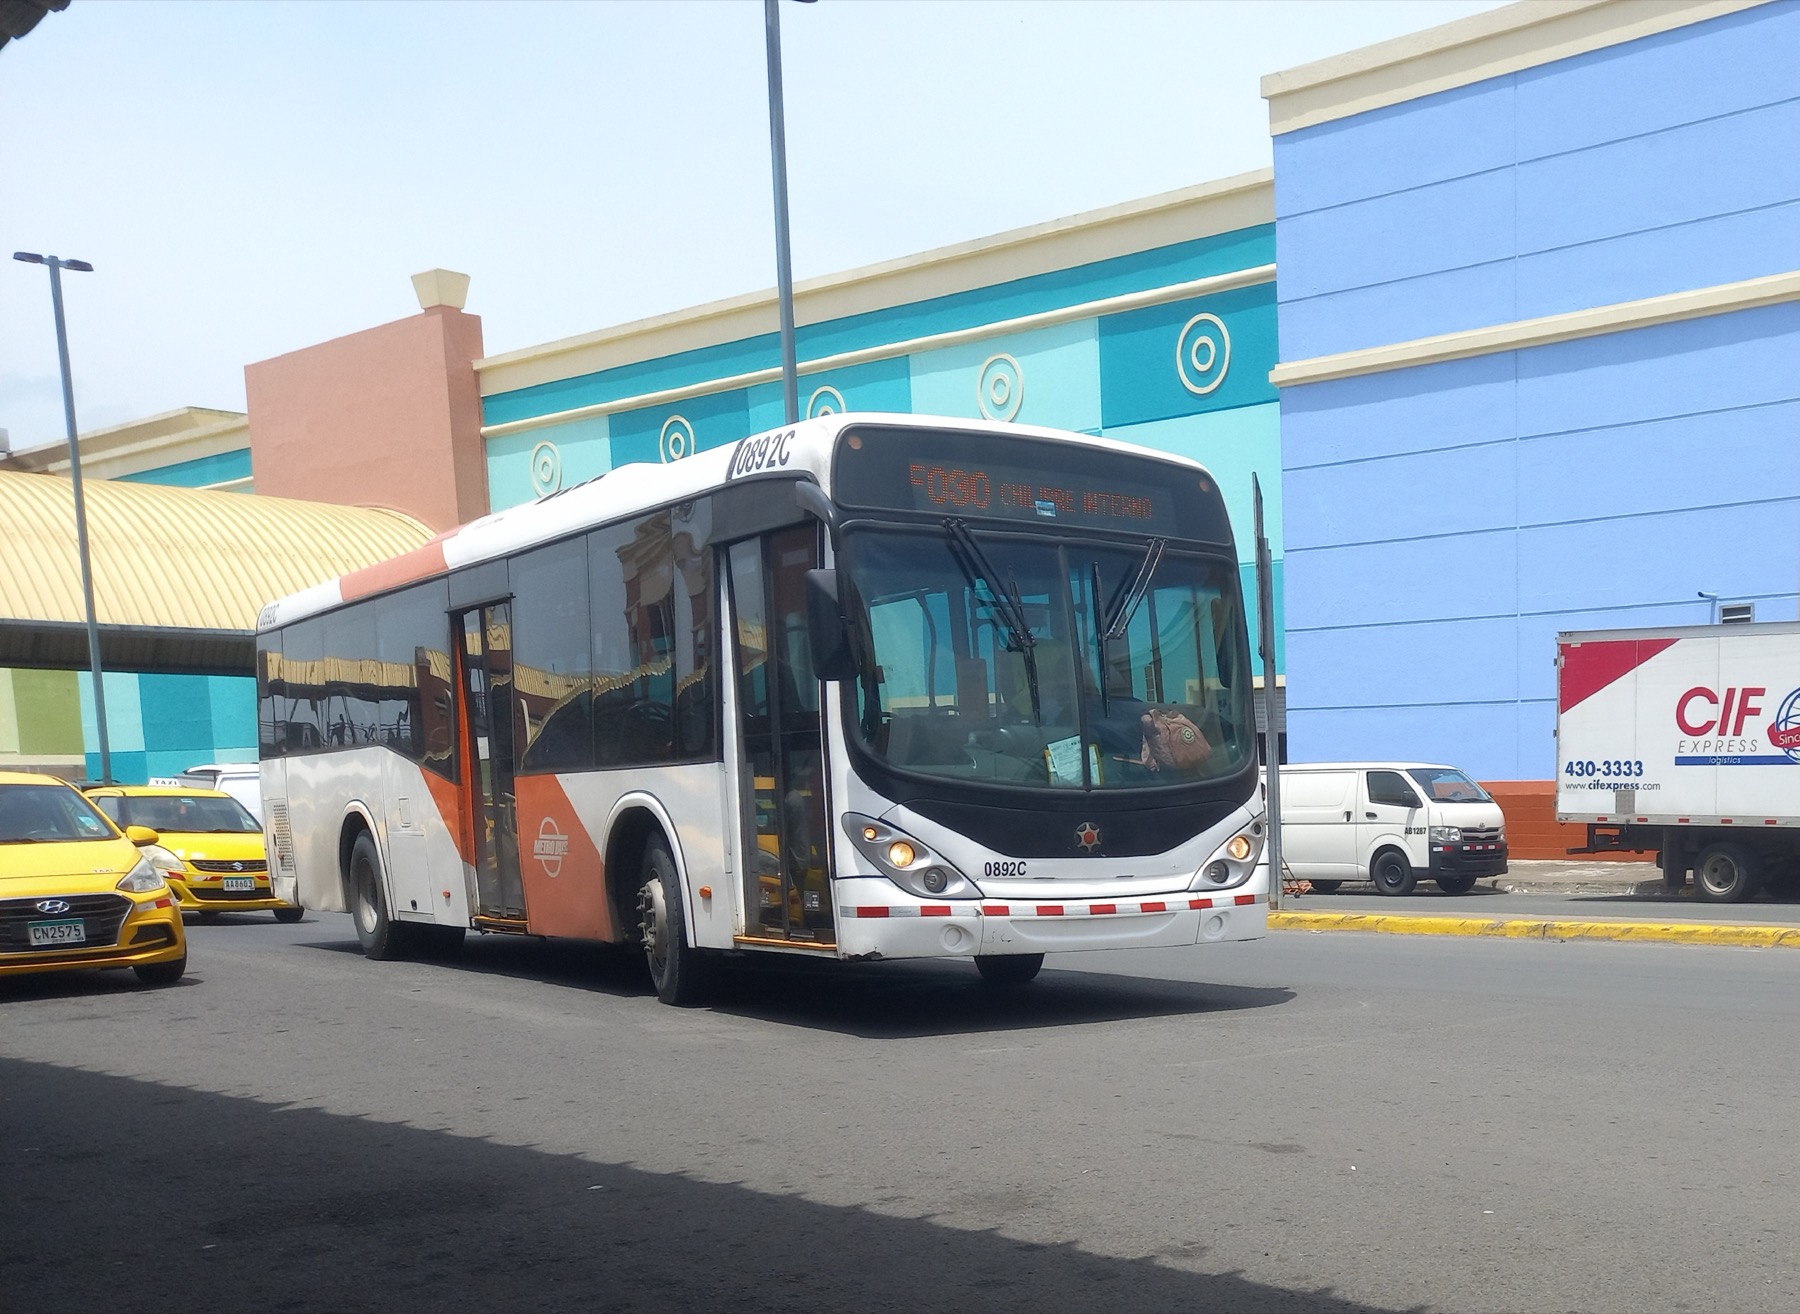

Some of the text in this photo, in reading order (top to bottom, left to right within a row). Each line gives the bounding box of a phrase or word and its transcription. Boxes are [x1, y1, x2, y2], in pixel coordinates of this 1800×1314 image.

[736, 429, 796, 475] 0892C
[1083, 492, 1152, 519] INTERNO
[1676, 686, 1766, 737] CIF
[1678, 739, 1758, 753] EXPRESS
[1779, 733, 1800, 745] Sinc
[1708, 756, 1741, 765] logistics
[1565, 760, 1644, 777] 430-3333
[1565, 779, 1661, 793] www.cifexpress.com
[1404, 826, 1427, 835] AB1287
[984, 861, 1027, 877] 0892C
[225, 880, 253, 888] AA8603
[33, 924, 81, 940] CN2575
